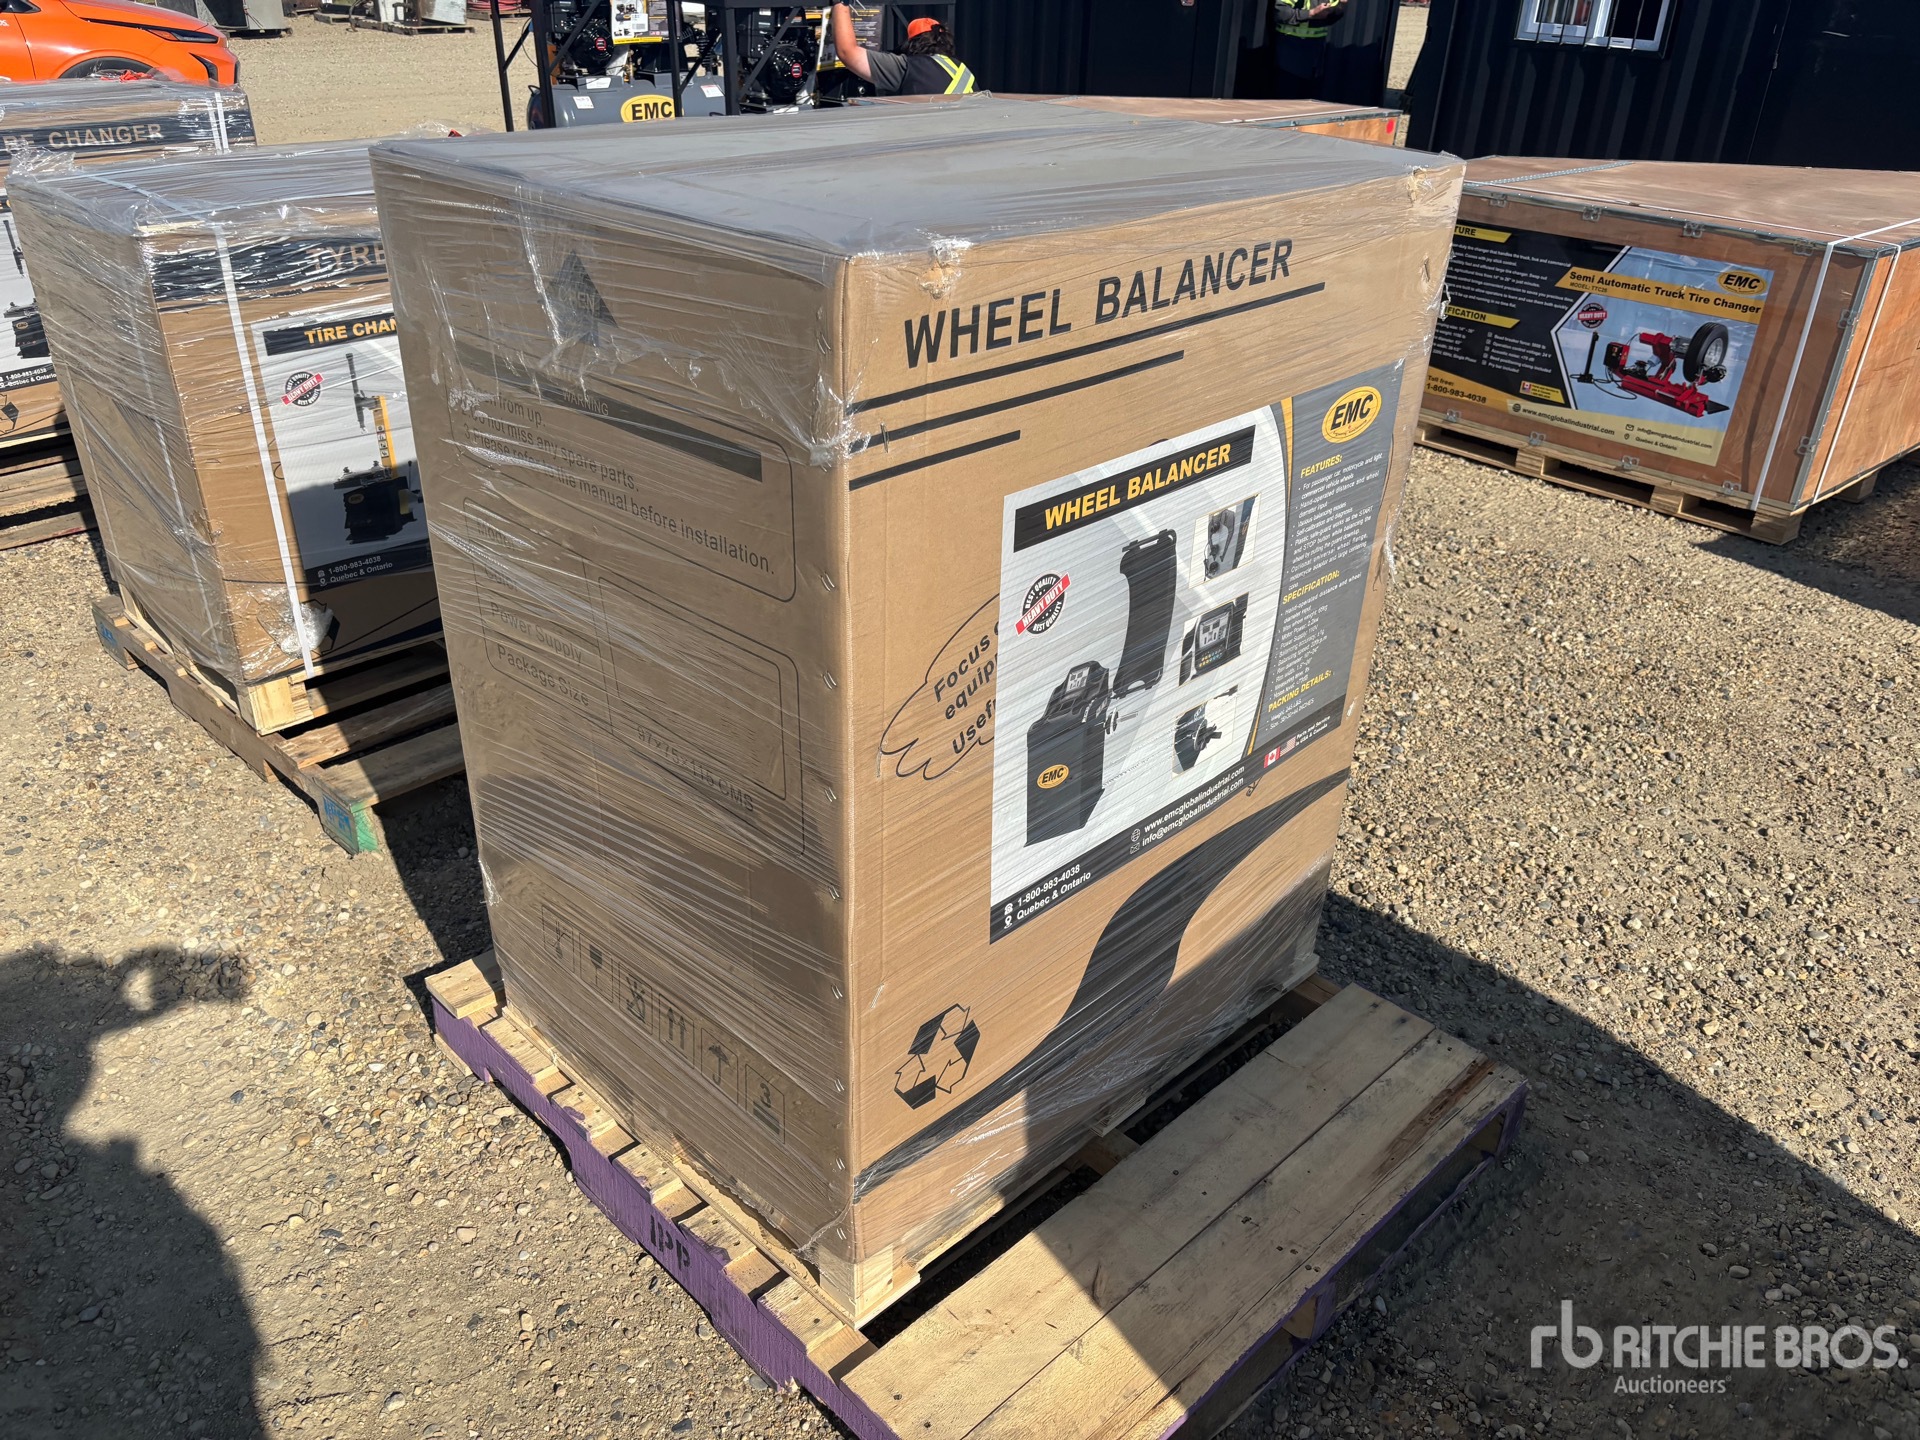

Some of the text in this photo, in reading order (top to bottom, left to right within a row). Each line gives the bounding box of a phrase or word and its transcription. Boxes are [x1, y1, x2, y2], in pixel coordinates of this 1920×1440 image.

[631, 101, 673, 121] EMC
[49, 123, 163, 148] CHANGER
[1570, 271, 1762, 316] Semi Automatic Truck Tire Changer
[1723, 273, 1761, 290] EMC
[904, 238, 1293, 368] WHEEL BALANCER
[304, 325, 348, 344] TIRE
[1426, 383, 1487, 404] 1-800-983-4038
[1428, 375, 1439, 383] Toll
[527, 406, 546, 427] up.
[563, 390, 609, 416] WARNING
[1330, 394, 1374, 431] EMC
[1522, 406, 1615, 436] www.emcglobalindustrial.com
[1635, 436, 1654, 445] Quebec
[1659, 442, 1678, 451] Ontario
[1637, 426, 1713, 450] info@emcglobalindustrial.com
[507, 424, 533, 444] miss
[561, 447, 597, 473] spare
[600, 460, 640, 493] parts.
[1300, 453, 1342, 478] FEATURES:
[1045, 443, 1231, 530] WHEEL BALANCER
[578, 477, 628, 517] manual
[630, 496, 678, 533] before
[680, 518, 775, 575] installation.
[1302, 539, 1316, 550] STOP
[328, 554, 382, 575] 1-800-983-4038
[329, 569, 359, 584] Quebec
[366, 561, 394, 575] Ontario
[1022, 580, 1064, 627] HEAVY DUTY
[1024, 590, 1036, 609] BEST
[1282, 568, 1340, 604] SPECIFICATION:
[489, 600, 583, 665] Power Supply
[1032, 623, 1046, 632] BEST
[497, 645, 589, 707] Package Size
[933, 634, 991, 702] Focus
[945, 652, 999, 720] equip
[1268, 668, 1331, 712] PACKING DETAILS:
[952, 698, 997, 754] Usef
[716, 772, 754, 813] CMS
[1041, 767, 1065, 784] EMC
[1142, 777, 1244, 848] info@emcglobalindustrial.com
[1143, 765, 1245, 834] www.emcglobalindustrial.com
[1016, 871, 1091, 920] Quebec & Ontario
[1017, 864, 1081, 907] 1-800-983-4038
